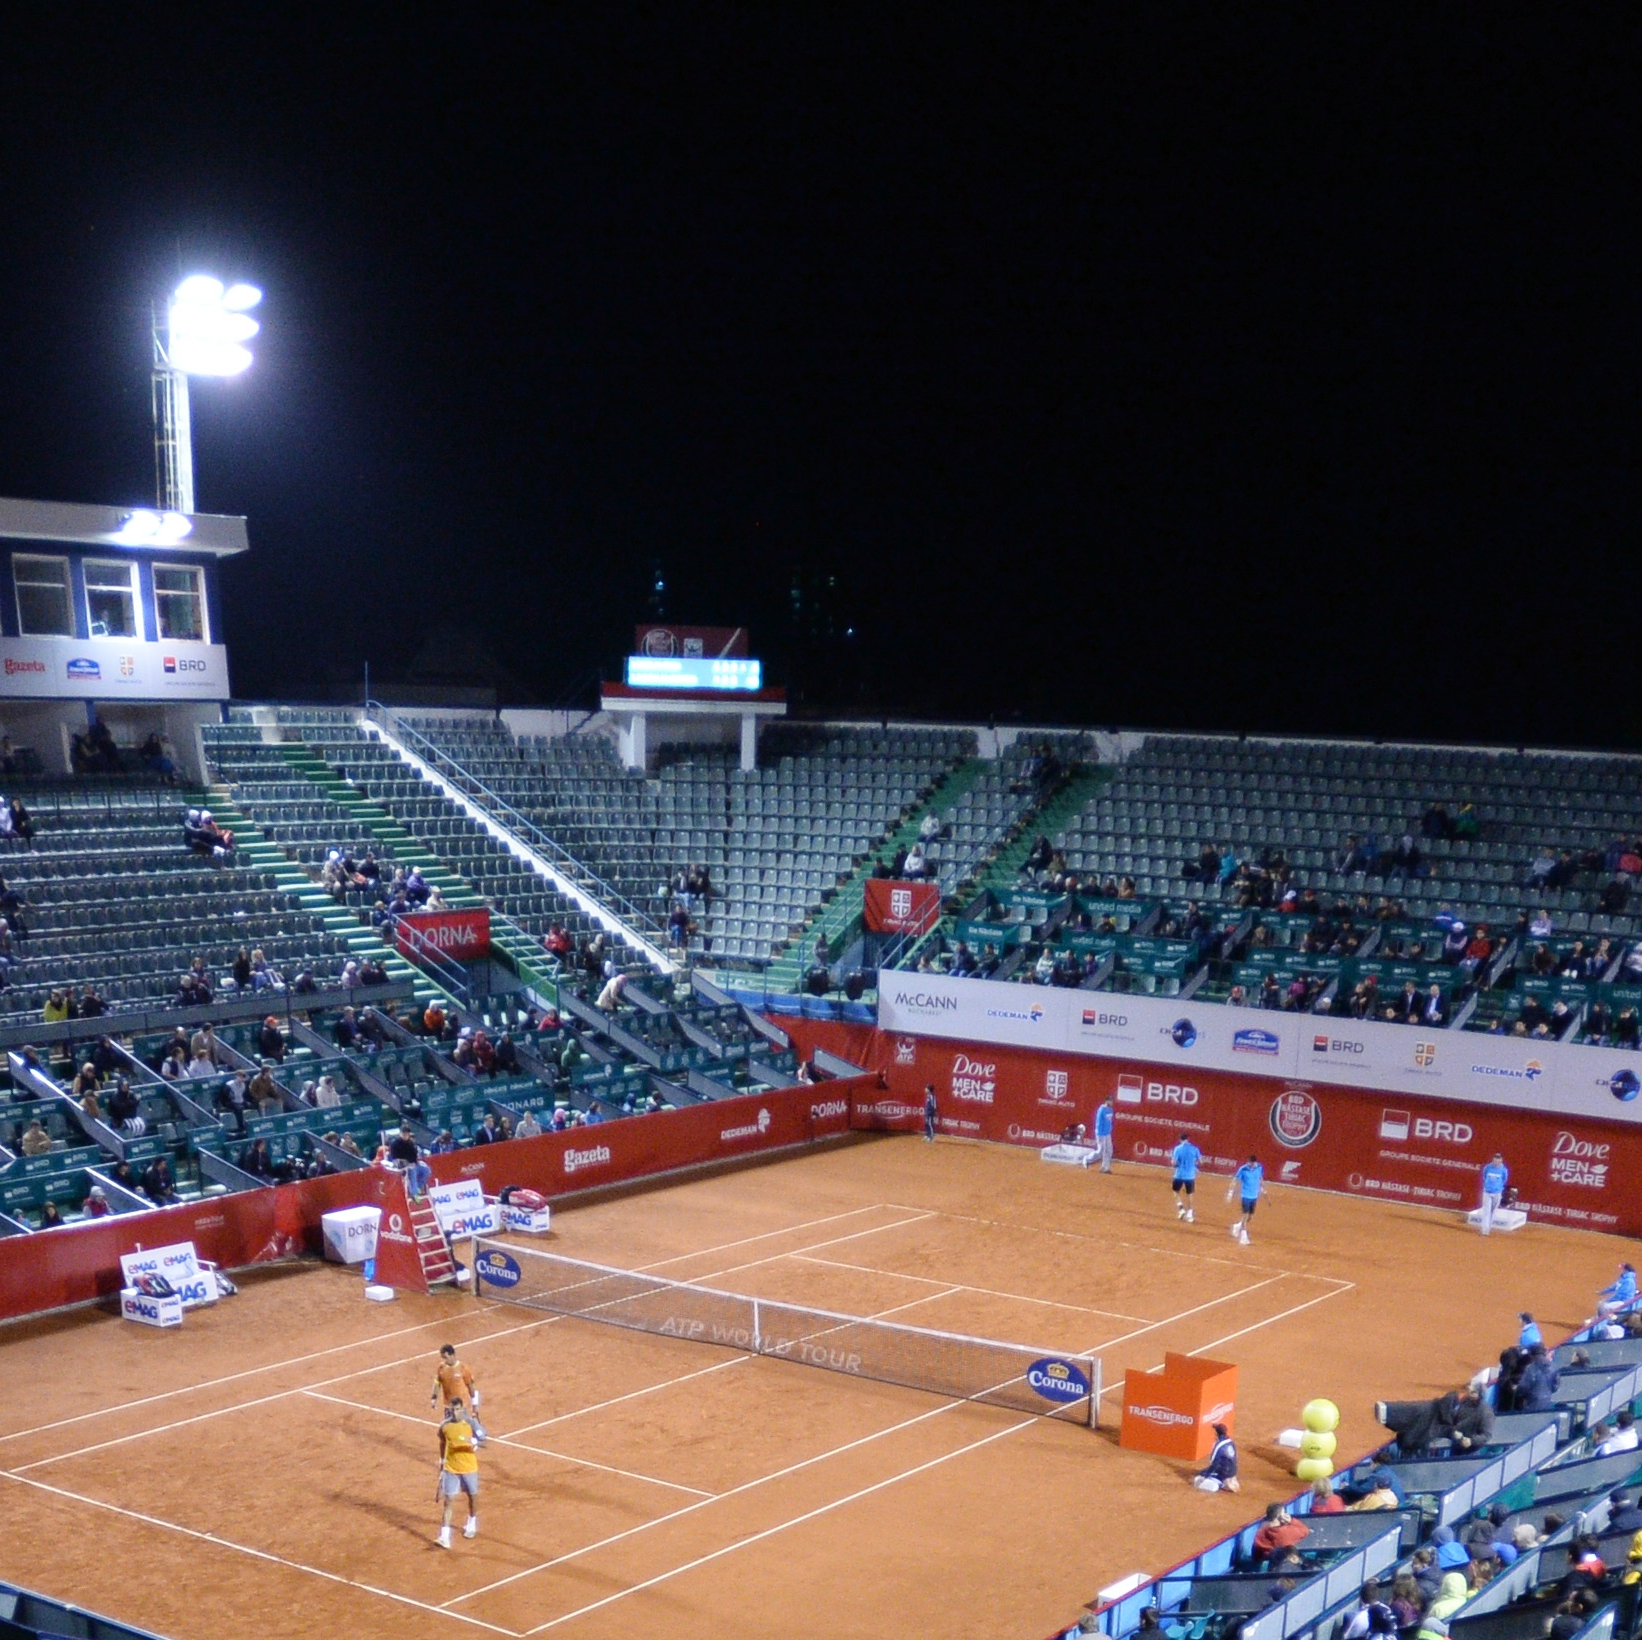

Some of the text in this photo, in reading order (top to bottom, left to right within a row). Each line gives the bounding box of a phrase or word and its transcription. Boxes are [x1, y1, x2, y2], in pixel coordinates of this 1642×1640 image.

[3, 657, 46, 675] gazeta
[178, 659, 207, 672] BRD
[408, 923, 478, 949] DORNA
[894, 991, 958, 1011] McCANN
[987, 1008, 1028, 1020] DEDEMAN
[1098, 1012, 1128, 1027] BRD
[1331, 1039, 1364, 1055] BRD
[952, 1053, 996, 1078] Dove
[1471, 1064, 1523, 1079] DEDEMAN
[952, 1076, 981, 1091] MEN
[952, 1087, 994, 1103] +CARE
[1146, 1082, 1199, 1105] BRD
[1288, 1094, 1305, 1104] BRD
[810, 1099, 849, 1119] DORNA
[856, 1103, 925, 1116] TRANSENERGO
[1115, 1111, 1210, 1132] GROUPE SOCIETE GENERALE
[1414, 1117, 1474, 1143] BRD
[720, 1123, 757, 1140] DEDEMAN
[1551, 1131, 1611, 1158] Dove
[563, 1145, 611, 1173] gazeta
[1379, 1149, 1482, 1172] GROUPE SOCIETE GENERALE
[1551, 1156, 1589, 1173] MEN
[1364, 1178, 1381, 1189] BRD
[1550, 1169, 1606, 1187] +CARE
[455, 1188, 480, 1201] eMAG
[500, 1209, 533, 1227] eMAG
[1514, 1201, 1531, 1211] BRD
[1590, 1210, 1619, 1224] TROPHY
[348, 1222, 378, 1238] DORN
[452, 1213, 494, 1235] eMAG
[379, 1230, 414, 1245] vodafone
[127, 1259, 158, 1275] eMAG
[163, 1252, 193, 1267] eMAG
[475, 1258, 520, 1283] Corona
[175, 1280, 208, 1303] MAG
[124, 1300, 158, 1320] eMAG
[658, 1315, 865, 1373] ATP WORLD TOUR
[1028, 1369, 1085, 1395] Corona
[1128, 1405, 1194, 1426] TRANSENERGO
